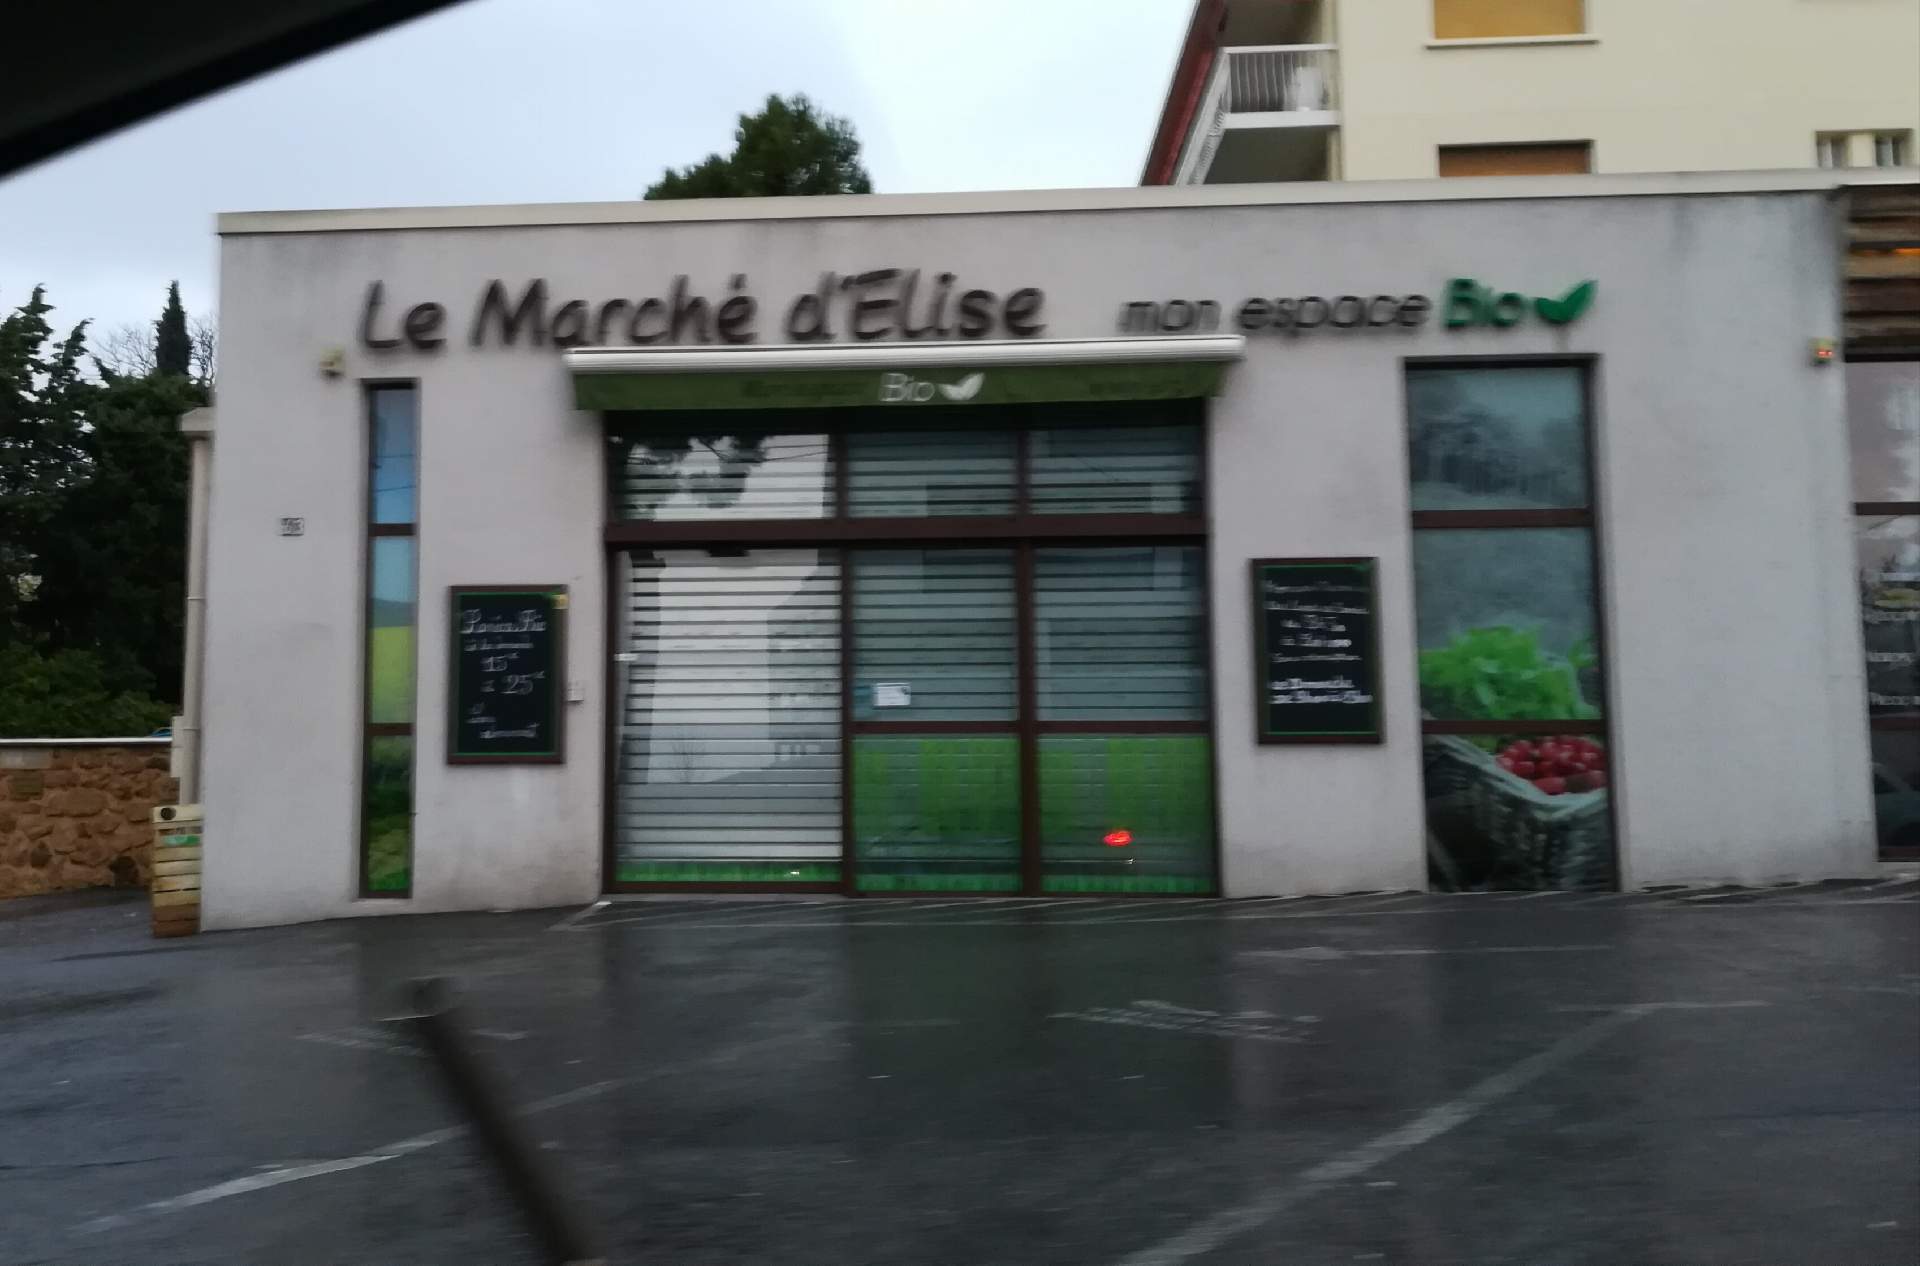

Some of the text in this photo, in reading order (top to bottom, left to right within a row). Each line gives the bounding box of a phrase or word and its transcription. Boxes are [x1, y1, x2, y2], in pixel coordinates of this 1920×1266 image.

[356, 268, 1047, 350] Le Marché d'Elise
[1117, 278, 1527, 338] mon espace Bio
[880, 372, 935, 402] Bio
